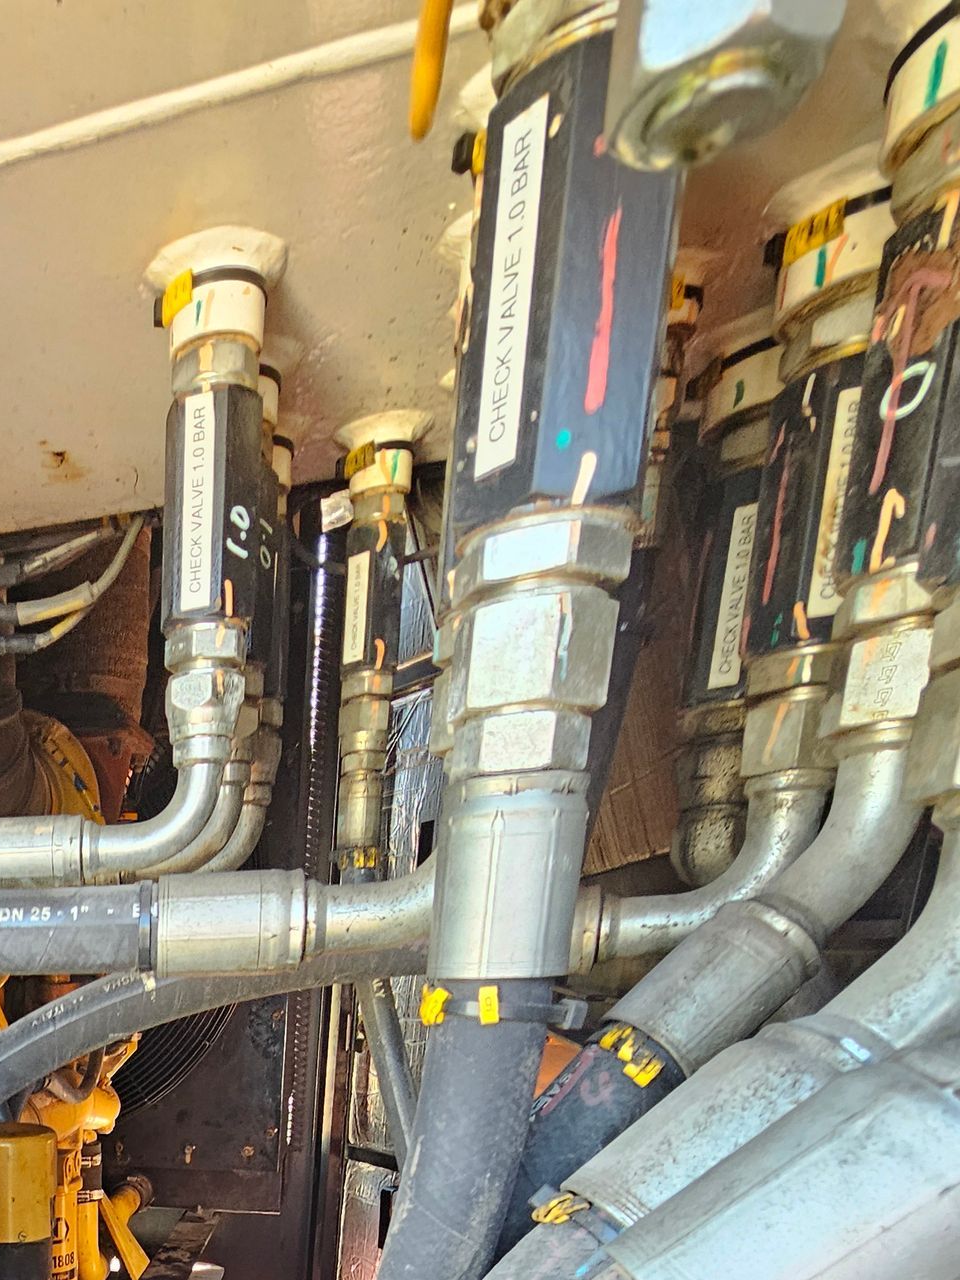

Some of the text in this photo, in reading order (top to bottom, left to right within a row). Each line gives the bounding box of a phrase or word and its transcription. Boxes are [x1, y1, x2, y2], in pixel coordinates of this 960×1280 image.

[489, 128, 533, 443] CHECK VALVE 1.0 BAR
[188, 406, 206, 594] CHECK VALVE 1.0 BAR
[226, 505, 250, 559] 1.0
[739, 516, 756, 547] BAR
[726, 573, 746, 625] VALVE
[719, 625, 739, 674] CHECK
[0, 907, 24, 922] DN
[30, 906, 52, 921] 25
